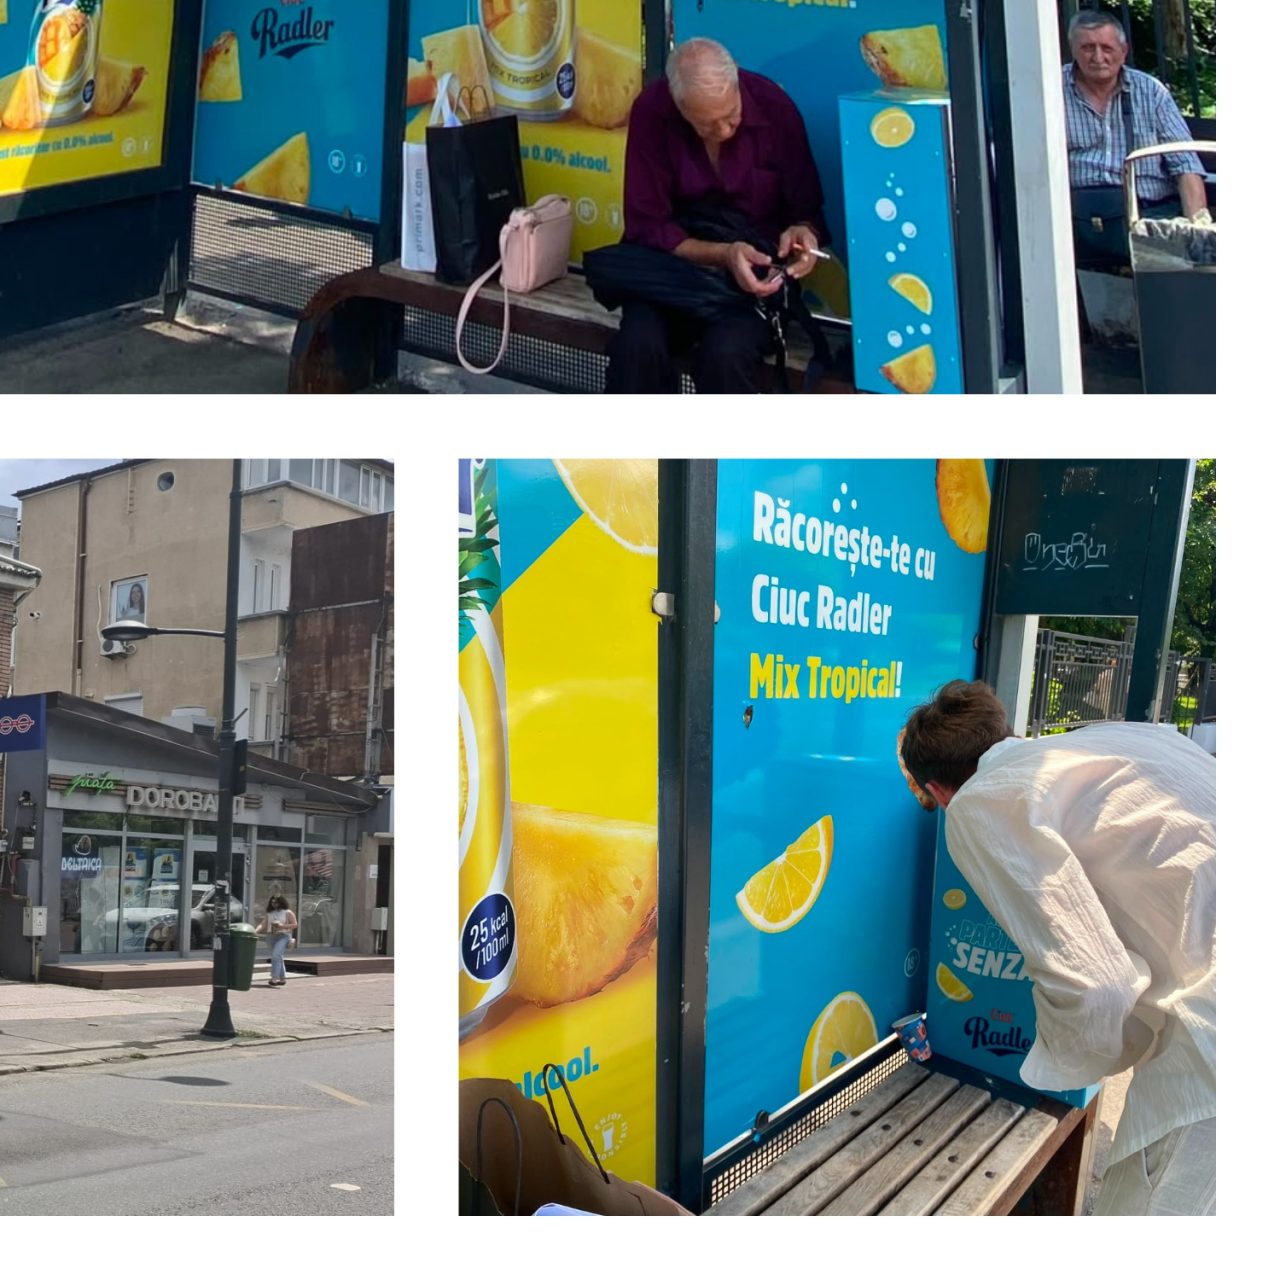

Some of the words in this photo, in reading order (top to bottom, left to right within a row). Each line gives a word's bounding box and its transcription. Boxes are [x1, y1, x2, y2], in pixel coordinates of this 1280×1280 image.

[251, 6, 334, 59] Radler
[507, 69, 551, 85] TROPICAL
[531, 144, 565, 165] 0.0%
[568, 152, 612, 173] alcool.
[753, 490, 911, 578] Răcorește-te
[914, 547, 935, 581] cu
[751, 574, 810, 628] Ciuc
[816, 584, 892, 636] Radler
[749, 652, 800, 699] Mix
[807, 656, 902, 704] Tropical!
[469, 918, 489, 951] 25
[490, 906, 508, 936] kcal
[964, 1016, 1031, 1057] Radle
